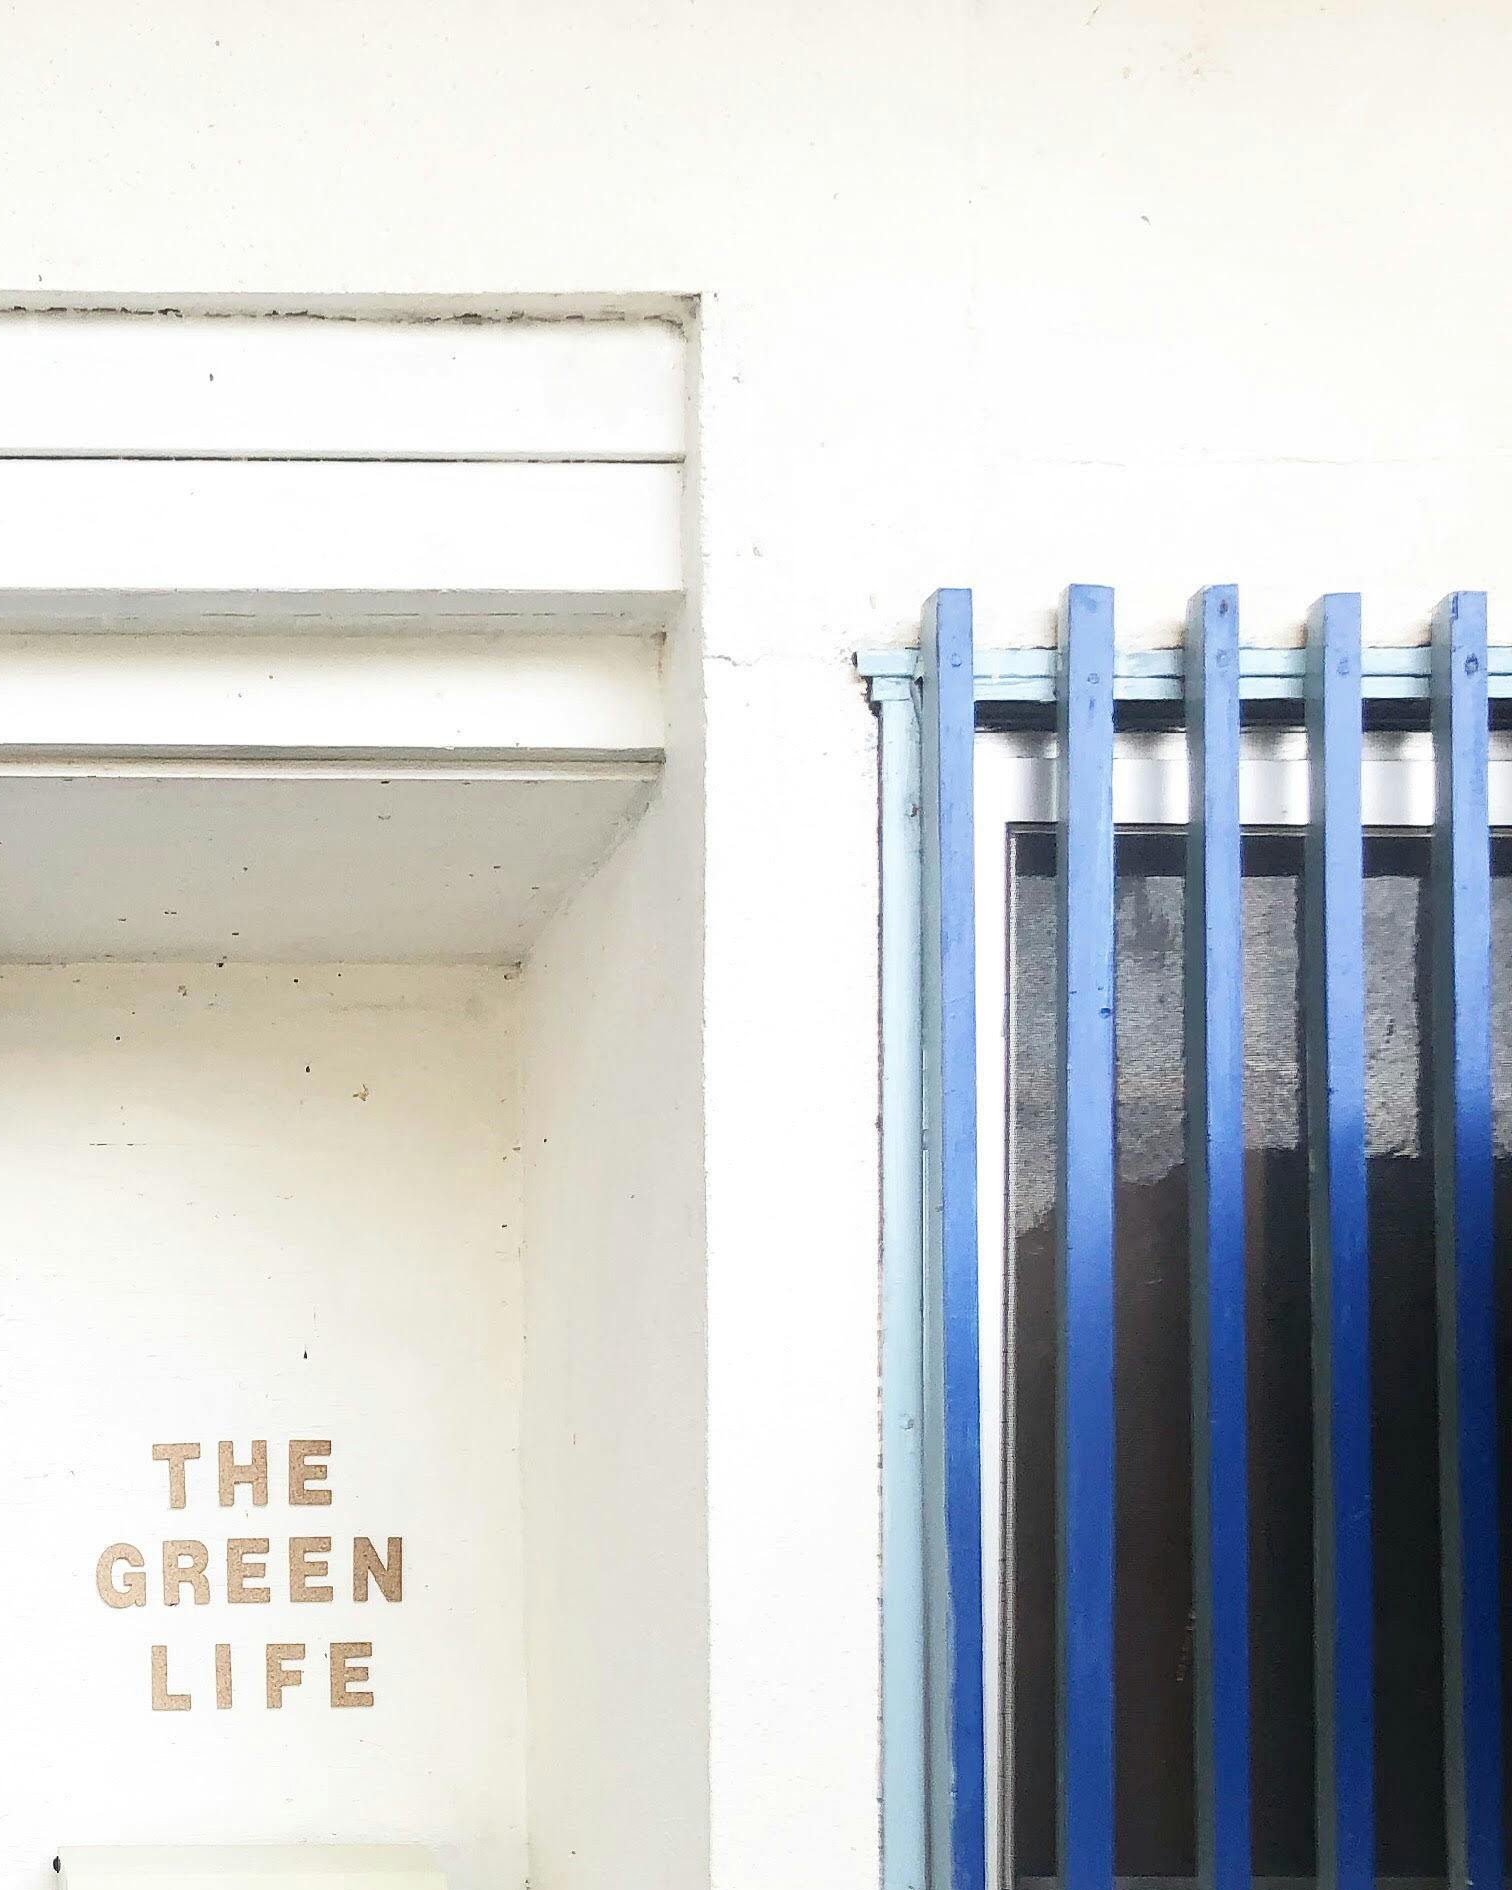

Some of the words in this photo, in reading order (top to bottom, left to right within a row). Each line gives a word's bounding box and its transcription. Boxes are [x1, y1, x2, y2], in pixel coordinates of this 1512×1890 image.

[152, 1440, 333, 1509] THE
[96, 1536, 403, 1608] GREEN
[151, 1642, 374, 1711] LIFE
